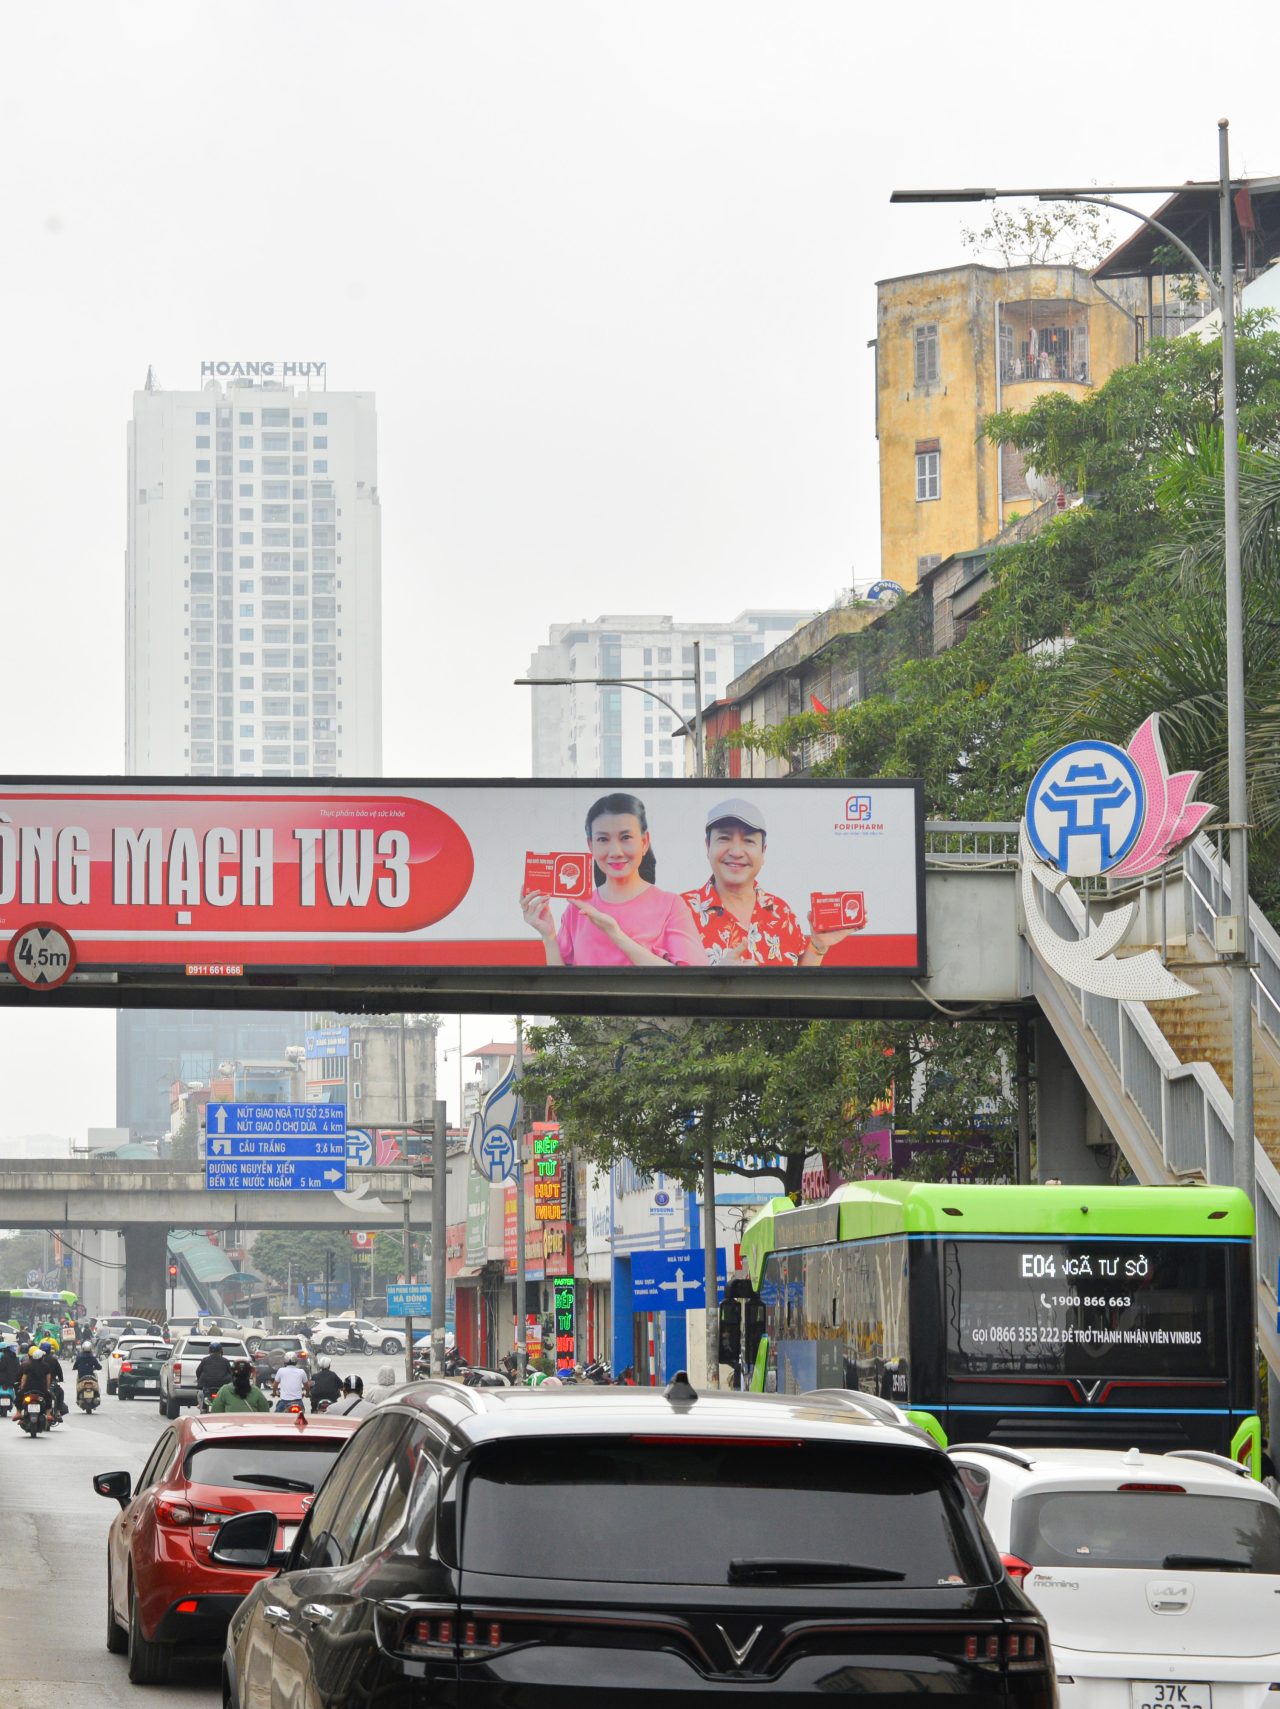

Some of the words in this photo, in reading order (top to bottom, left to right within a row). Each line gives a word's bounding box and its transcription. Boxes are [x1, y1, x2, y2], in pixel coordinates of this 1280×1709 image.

[200, 361, 274, 376] HOANG
[283, 361, 327, 377] HUY
[112, 826, 274, 925] MẠCH
[292, 828, 411, 908] TW3
[18, 937, 67, 969] 4,5m
[188, 966, 208, 974] 0911
[210, 966, 224, 974] 661
[226, 966, 241, 974] 666
[237, 1106, 253, 1118] NÚT
[255, 1108, 273, 1118] GIAO
[275, 1106, 292, 1118] NGÃ
[294, 1108, 305, 1118] TƯ
[306, 1105, 317, 1118] SỞ
[318, 1108, 329, 1119] 2,5
[330, 1108, 343, 1118] km
[237, 1119, 253, 1132] NÚT
[255, 1121, 273, 1132] GIAO
[275, 1119, 281, 1132] Ô
[282, 1121, 299, 1134] CHỢ
[300, 1119, 317, 1132] DỪA
[323, 1121, 328, 1132] 4
[330, 1121, 343, 1132] km
[258, 1139, 286, 1153] TRẮNG
[315, 1143, 328, 1154] 3,6
[330, 1143, 343, 1153] km
[534, 1135, 559, 1155] BẾP
[209, 1161, 237, 1174] ĐƯỜNG
[240, 1160, 272, 1174] NGUYỄN
[276, 1160, 295, 1174] XIỂN
[537, 1159, 557, 1176] TỪ
[209, 1174, 226, 1187] BẾN
[229, 1177, 239, 1187] XE
[242, 1175, 265, 1187] NƯỚC
[268, 1175, 292, 1187] NGẦM
[300, 1177, 305, 1187] 5
[309, 1177, 321, 1187] km
[535, 1181, 560, 1198] HÚT
[535, 1203, 561, 1220] MÙI
[1022, 1254, 1056, 1278] E04
[1098, 1257, 1119, 1275] TƯ
[1125, 1254, 1148, 1276] SỞ
[555, 1290, 574, 1308] BẾP
[1052, 1296, 1080, 1306] 1900
[1084, 1296, 1106, 1306] 866
[1109, 1296, 1131, 1307] 663
[559, 1313, 572, 1330] TỪ
[972, 1329, 988, 1344] GỌI
[990, 1327, 1016, 1342] 0866
[1018, 1327, 1037, 1342] 355
[1040, 1327, 1059, 1343] 222
[1062, 1325, 1073, 1343] ĐỂ
[1074, 1326, 1092, 1343] TRỞ
[1092, 1328, 1122, 1343] THÀNH
[1124, 1328, 1149, 1344] NHÂN
[1149, 1328, 1169, 1344] VIÊN
[1170, 1331, 1202, 1344] VINBUS
[1033, 1580, 1079, 1590] morning
[1154, 1684, 1188, 1702] 37K
